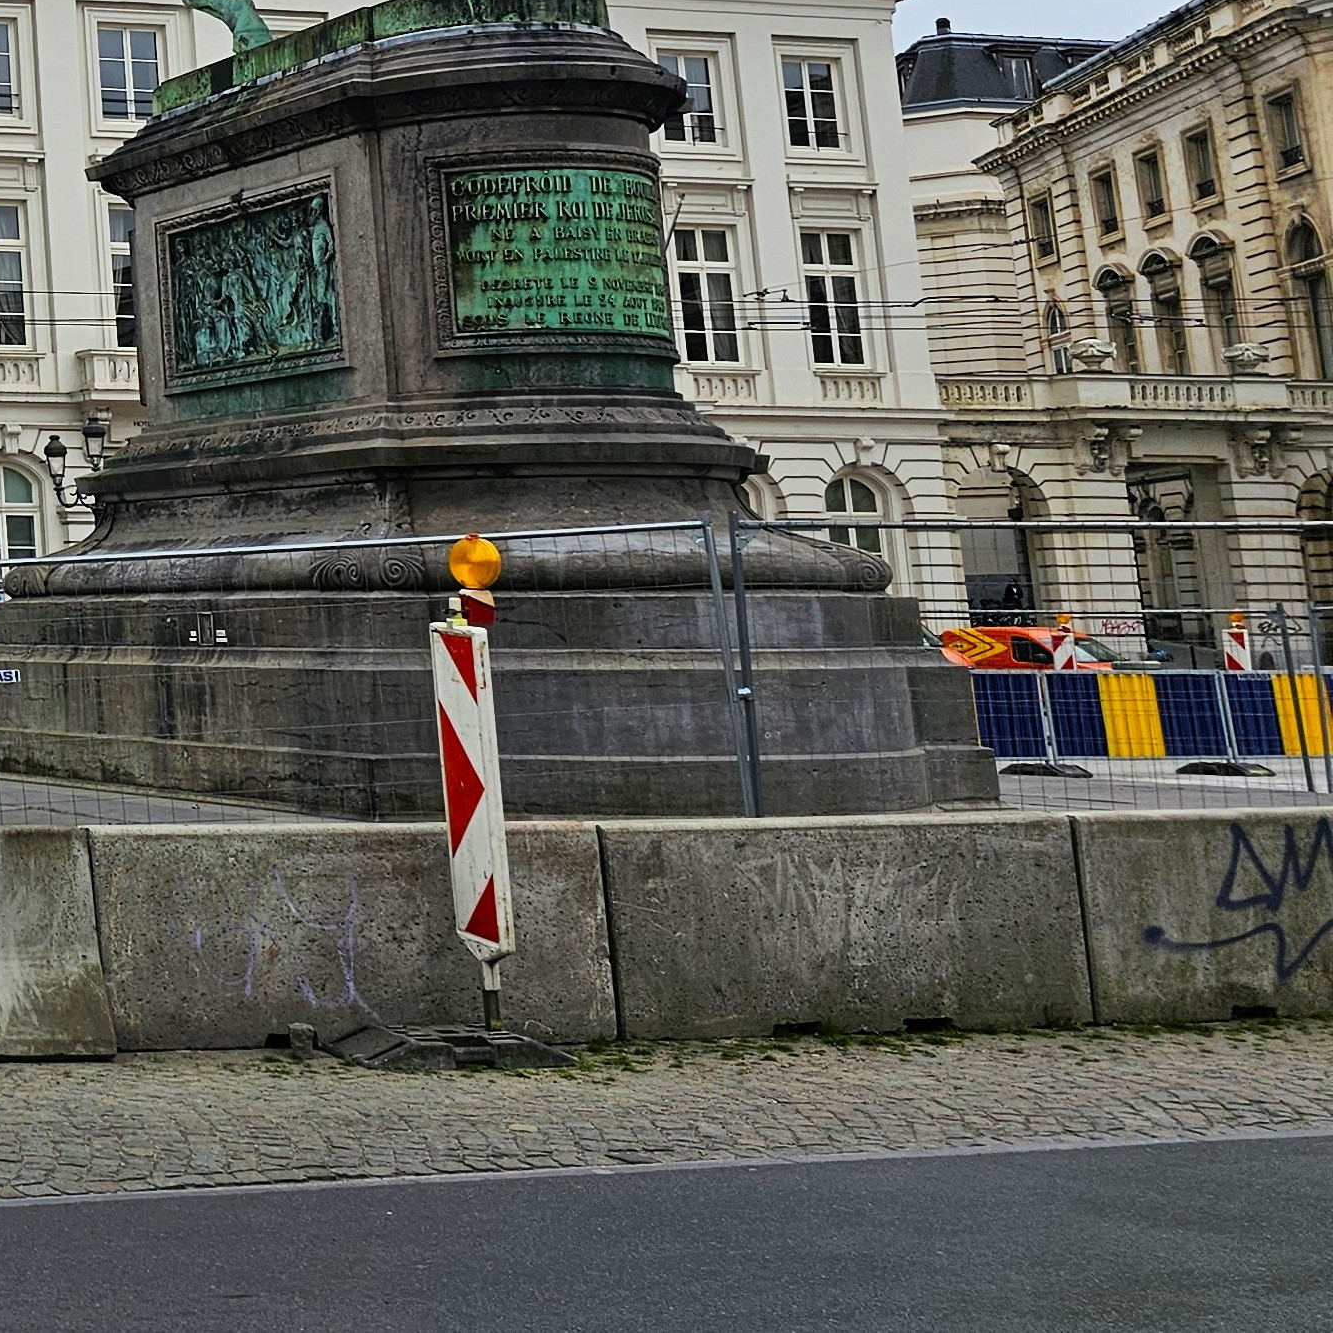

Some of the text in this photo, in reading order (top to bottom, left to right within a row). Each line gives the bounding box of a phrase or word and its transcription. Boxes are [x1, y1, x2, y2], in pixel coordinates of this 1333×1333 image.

[451, 175, 573, 198] GODEFROID
[590, 176, 614, 194] DE
[452, 201, 550, 223] PREMIER
[557, 200, 589, 221] ROI
[594, 202, 614, 219] DE
[555, 226, 599, 243] BAISY
[606, 228, 624, 242] EN
[535, 248, 612, 263] PALESTINE
